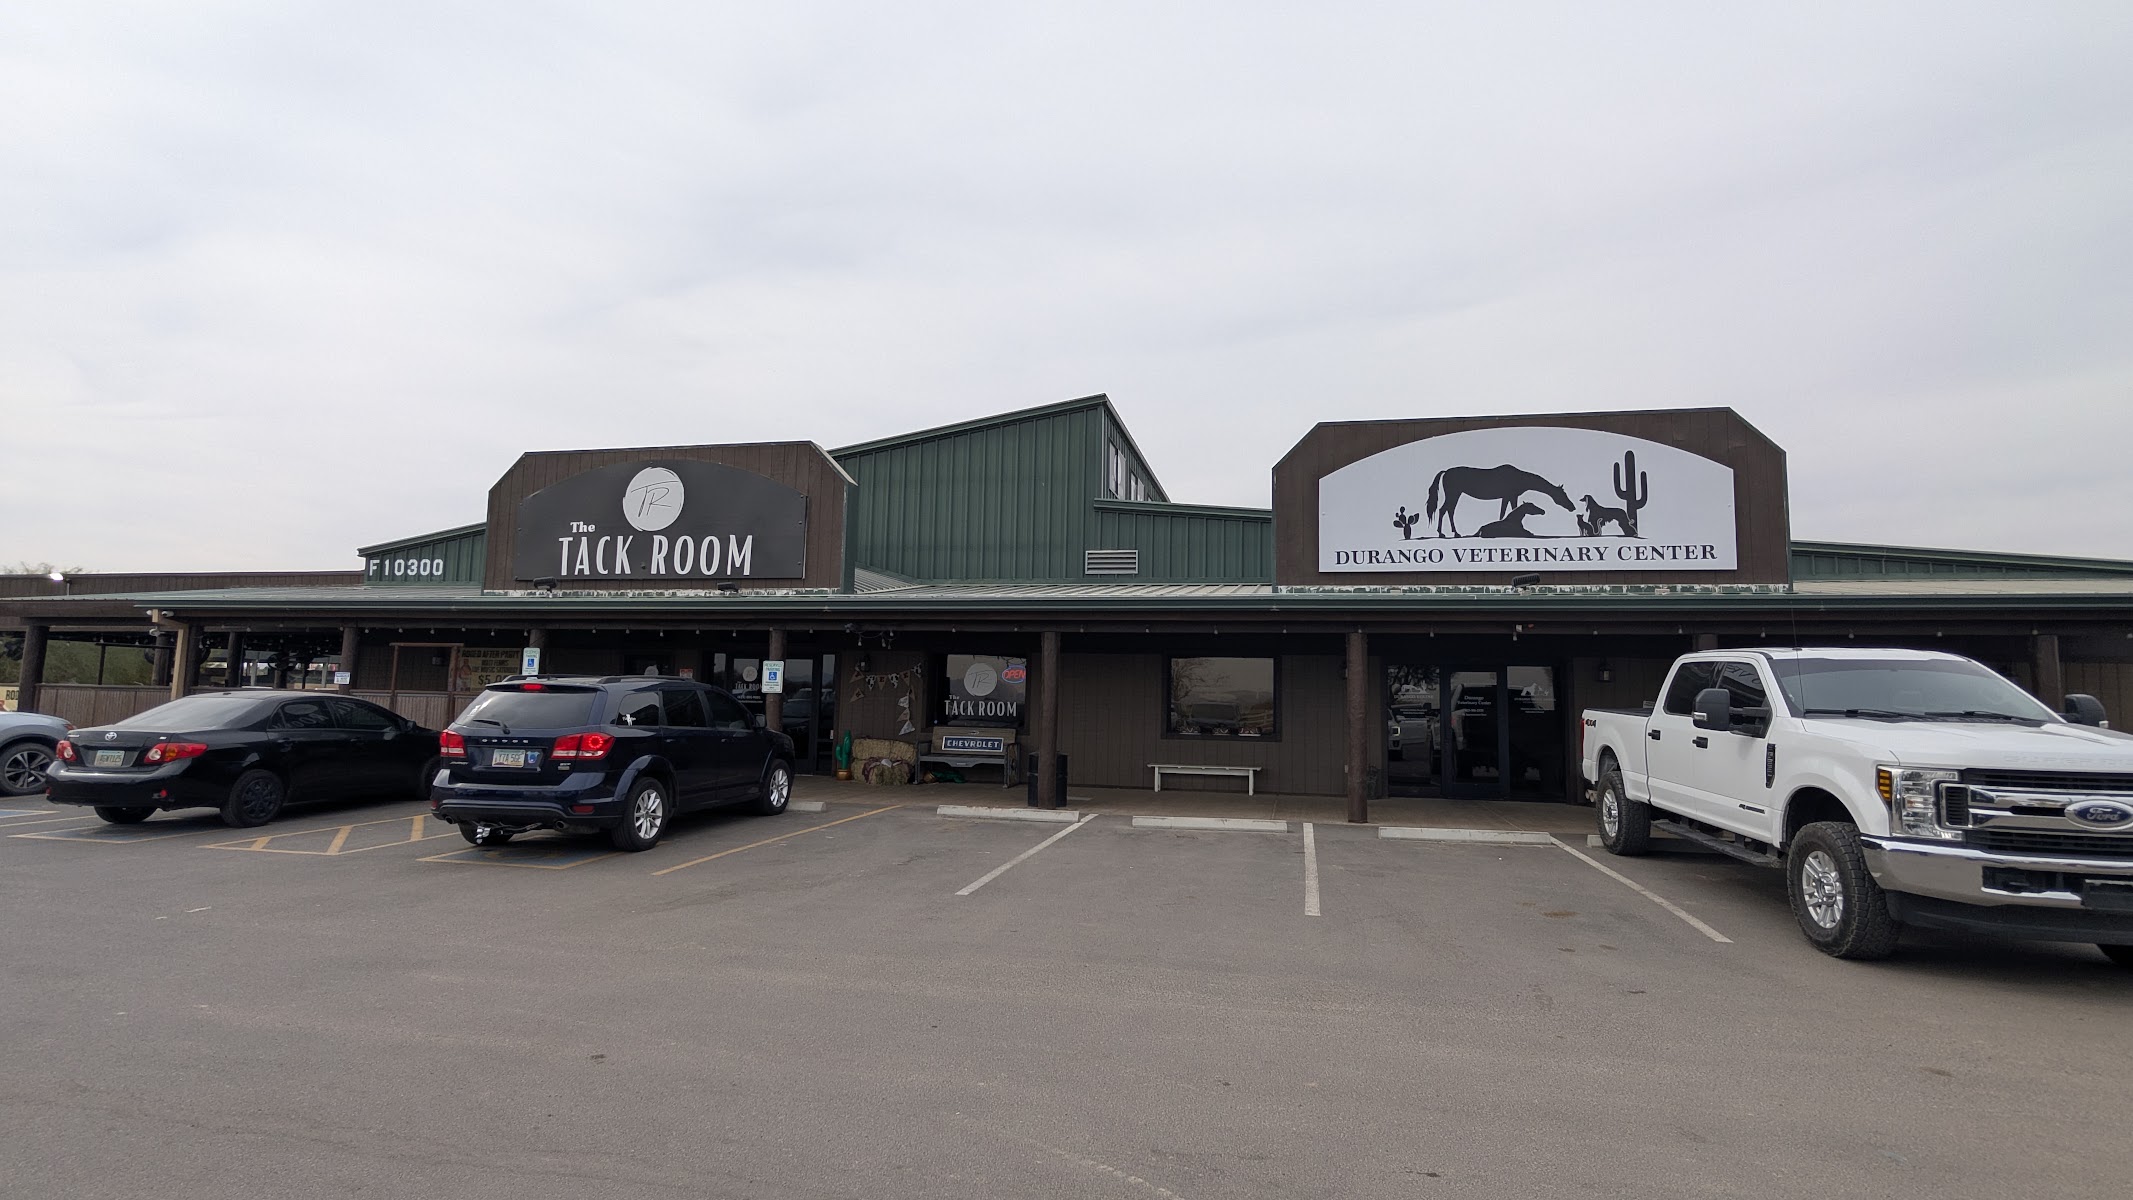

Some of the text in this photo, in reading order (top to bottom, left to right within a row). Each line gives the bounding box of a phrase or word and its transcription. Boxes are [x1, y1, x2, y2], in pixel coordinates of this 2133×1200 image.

[570, 521, 596, 533] The
[559, 535, 753, 576] TACK ROOM
[1335, 545, 1718, 565] DURANGO VETERINARY CENTER
[1003, 669, 1026, 679] OPEN
[944, 700, 1017, 717] TACK ROOM
[947, 739, 1000, 748] CHEVROLET
[2086, 807, 2122, 821] Ford
